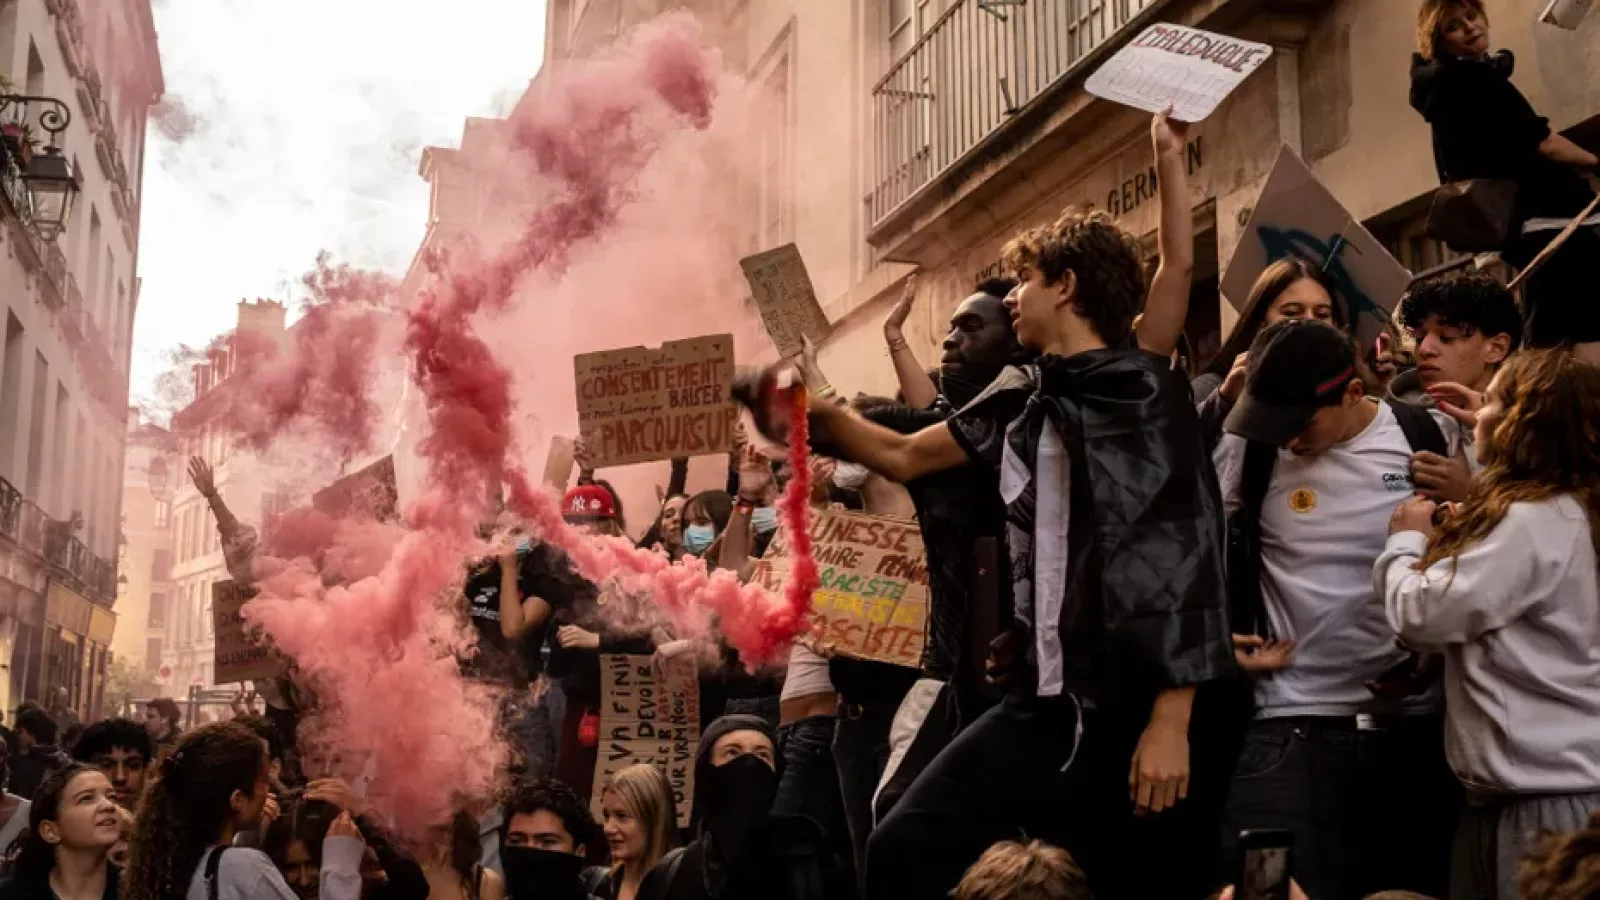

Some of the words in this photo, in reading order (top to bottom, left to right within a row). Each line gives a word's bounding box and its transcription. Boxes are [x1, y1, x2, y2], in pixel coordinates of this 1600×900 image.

[581, 357, 726, 400] CONSENTEMENT
[669, 383, 722, 409] BAISER
[601, 407, 738, 460] PARCOURSUP
[811, 515, 922, 552] UNESSE
[811, 615, 923, 657] ASCISTE
